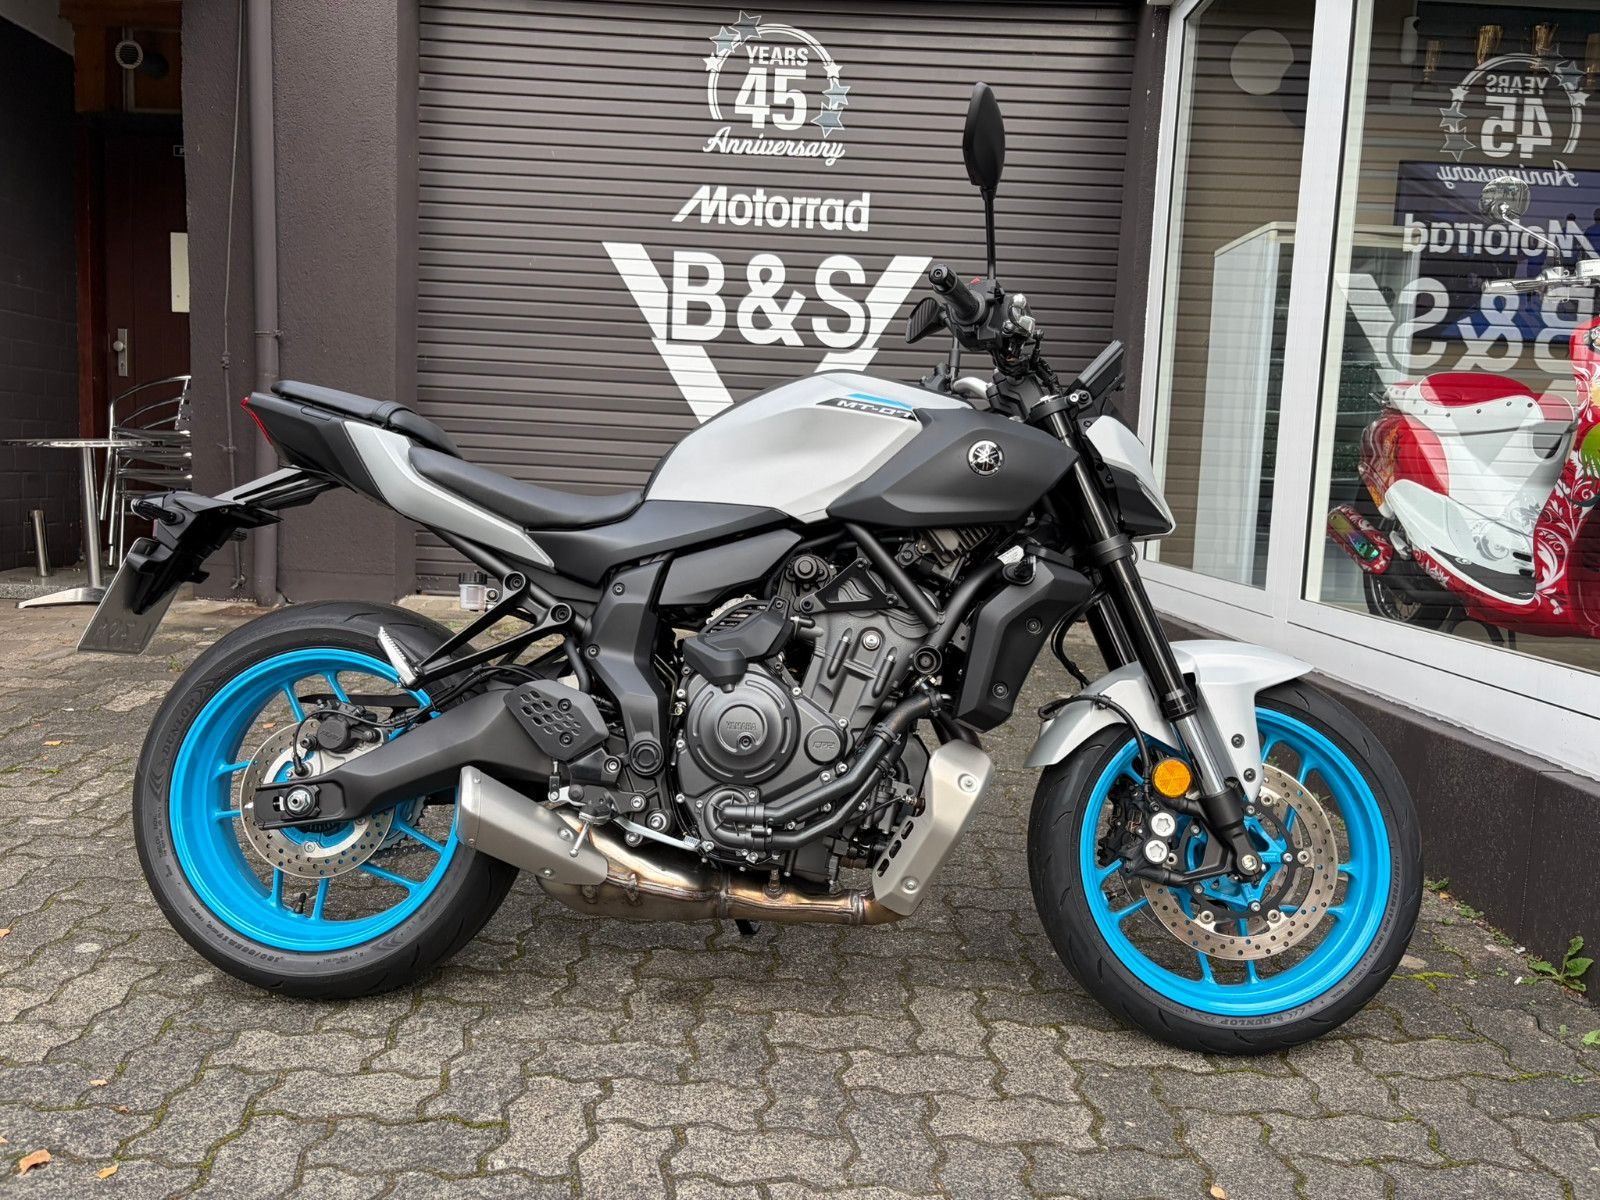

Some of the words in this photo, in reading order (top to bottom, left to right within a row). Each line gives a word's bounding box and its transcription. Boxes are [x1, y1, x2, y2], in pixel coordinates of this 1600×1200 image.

[745, 45, 809, 66] YEARS
[735, 67, 807, 131] 45
[702, 126, 846, 167] Anniversary
[672, 184, 871, 232] Motorrad
[837, 400, 912, 418] MT-07
[162, 699, 201, 761] DUNLOP
[726, 720, 757, 730] YAMAHA
[1220, 1017, 1272, 1026] DUNLOP
